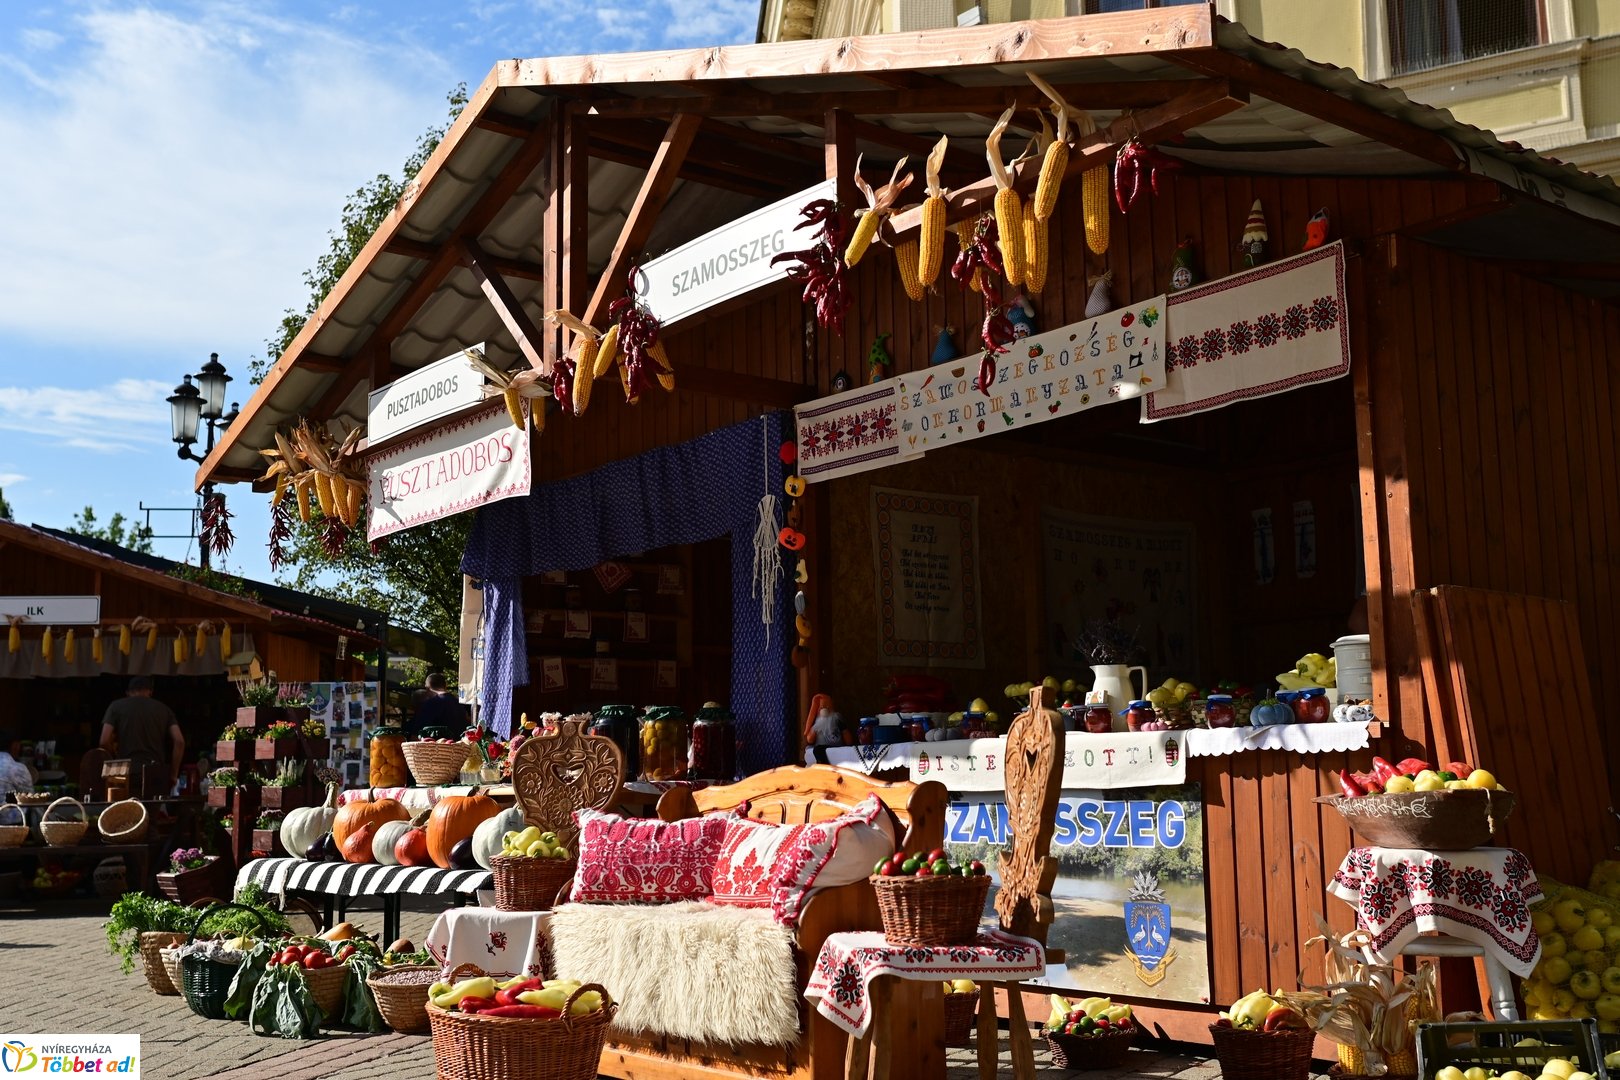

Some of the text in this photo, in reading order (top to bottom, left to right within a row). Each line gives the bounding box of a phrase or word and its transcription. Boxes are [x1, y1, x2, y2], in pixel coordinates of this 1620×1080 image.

[671, 229, 785, 297] SZAMOSSZEG
[387, 375, 459, 420] PUSZTADOBOS
[378, 432, 514, 505] PUSZTADOBOS
[26, 606, 44, 616] ILK
